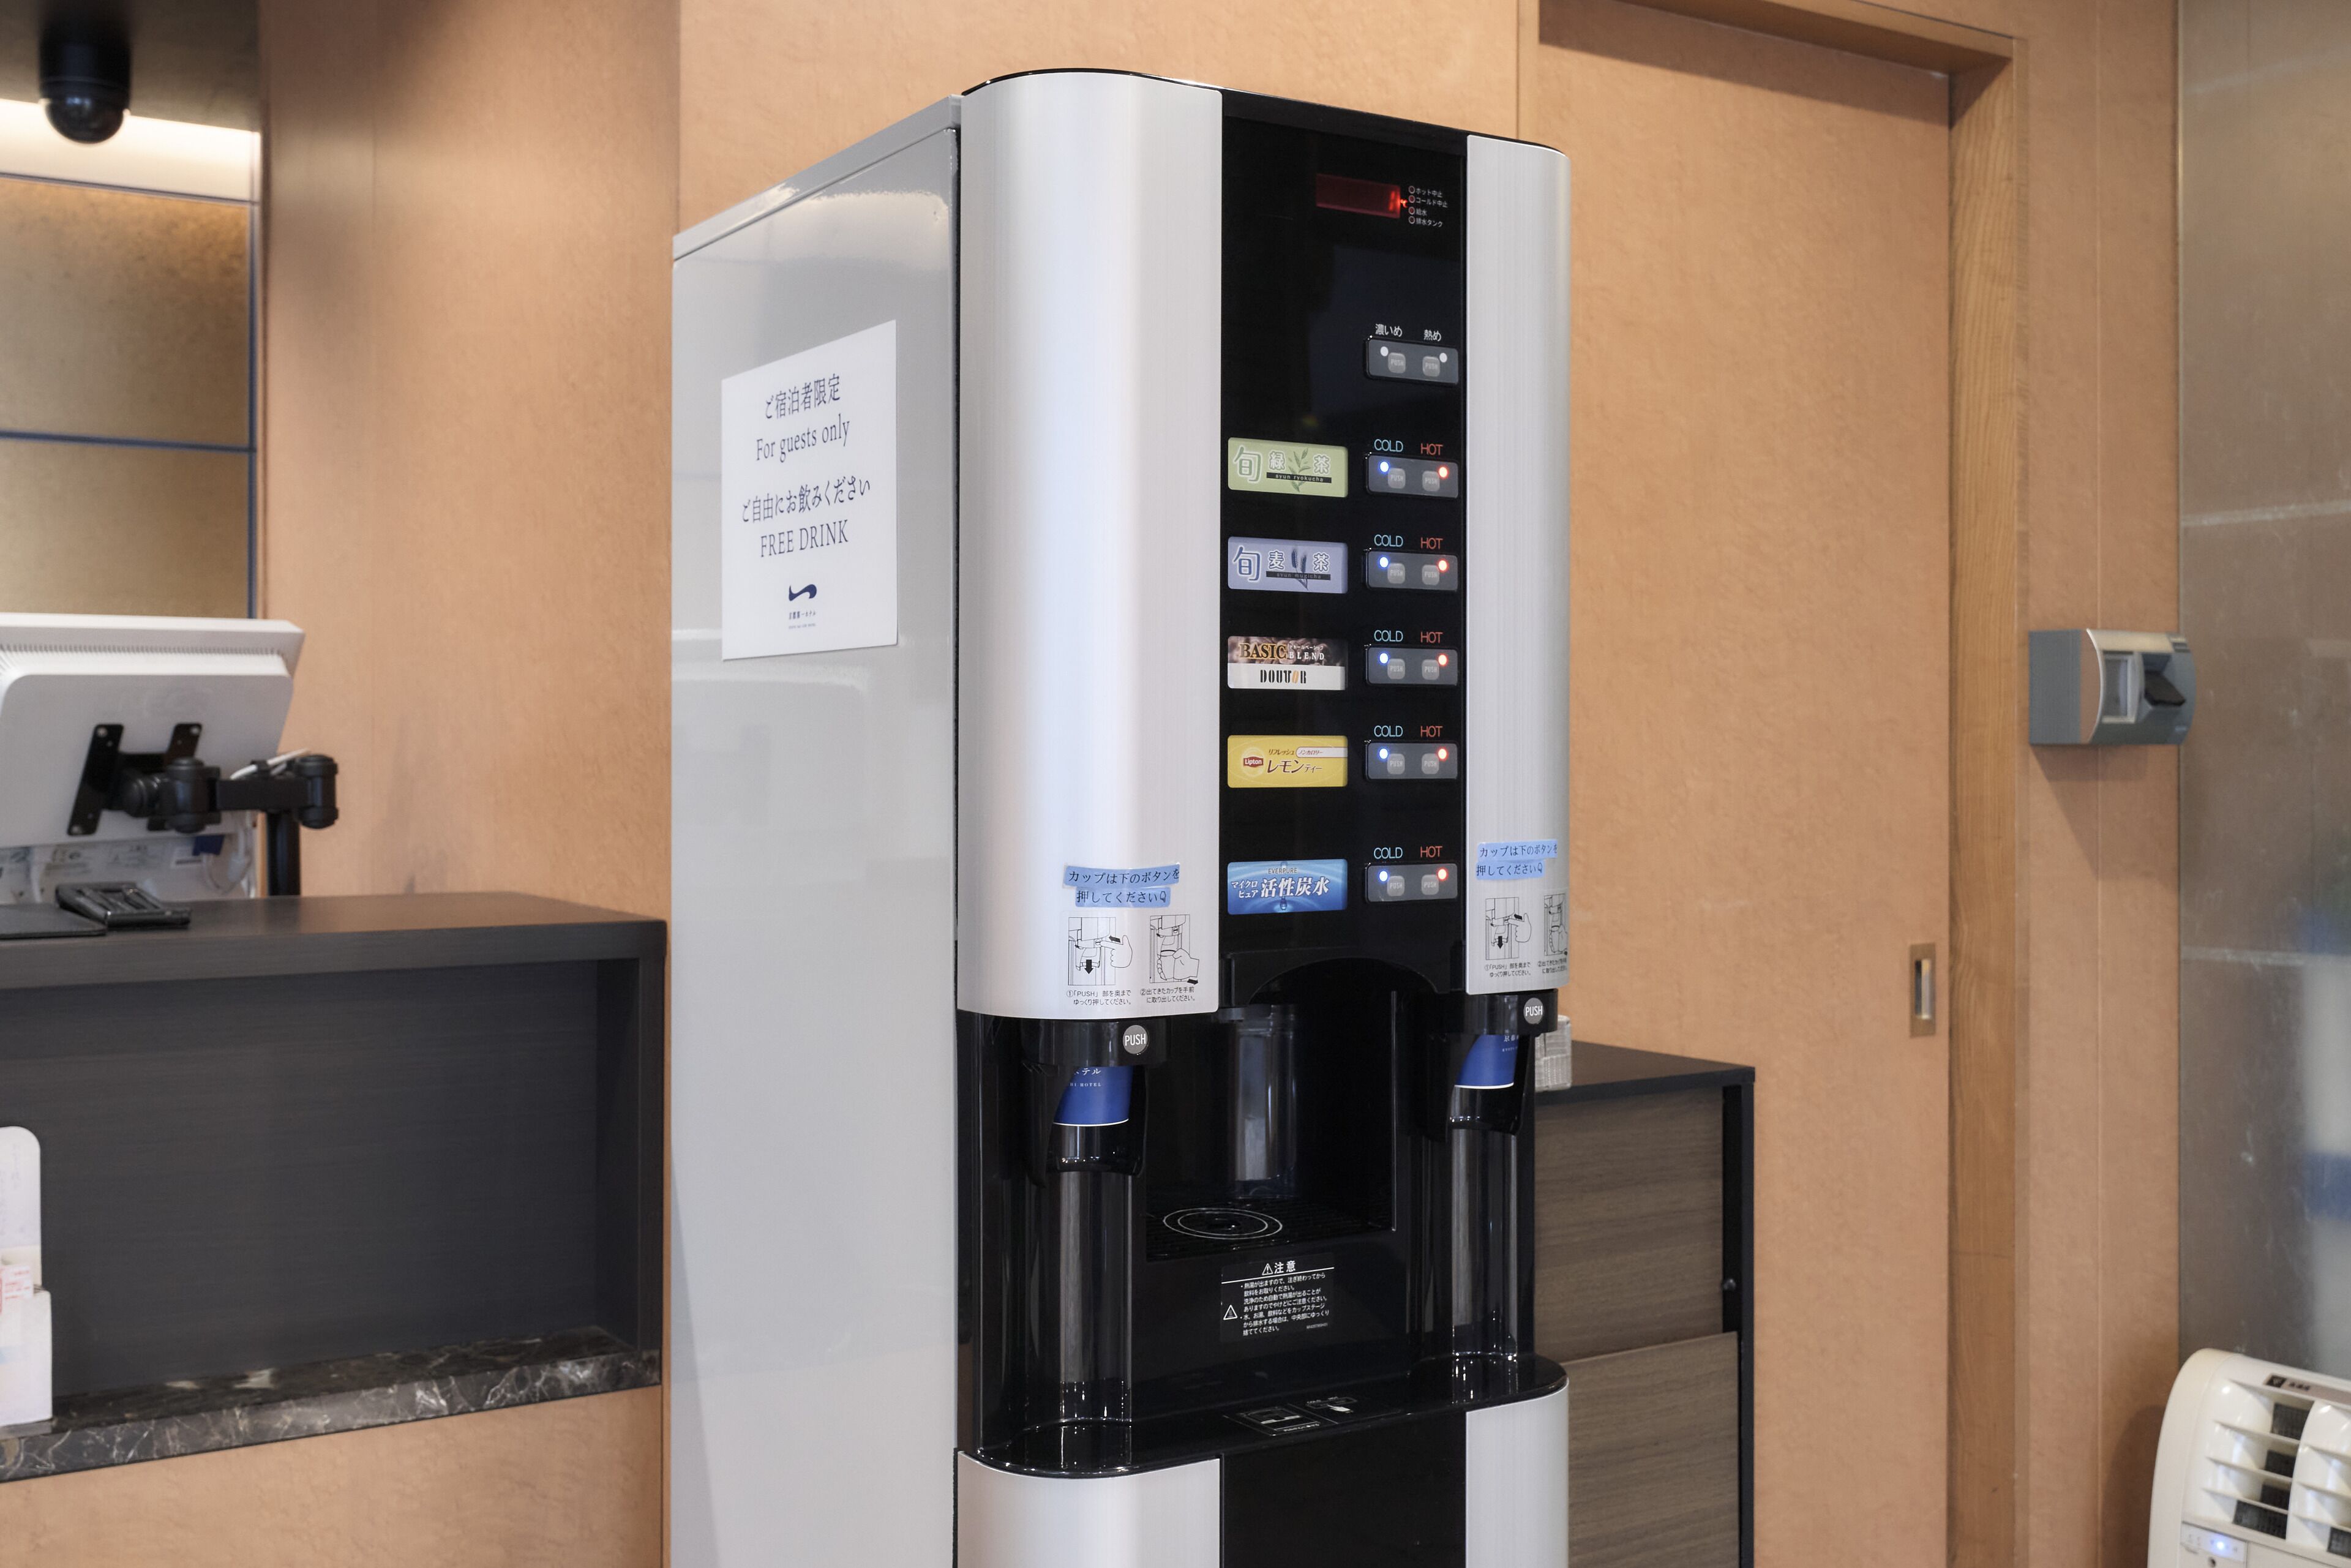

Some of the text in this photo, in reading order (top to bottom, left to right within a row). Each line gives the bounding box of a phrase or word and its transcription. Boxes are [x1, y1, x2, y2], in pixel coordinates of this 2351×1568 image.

[1375, 323, 1442, 342] 濃いめ 熱め
[765, 373, 841, 419] ご宿泊者限定
[756, 413, 850, 463] For guests only
[1374, 438, 1444, 456] COLD HOT
[742, 475, 871, 523] ご自由にお飲みください
[760, 519, 849, 557] FREE DRINK
[1374, 534, 1444, 549] COLD HOT
[1374, 629, 1444, 643] COLD HOT
[1239, 643, 1287, 659] BASIC
[1289, 651, 1325, 660] BLEND
[1374, 725, 1444, 738] COLD HOT
[1267, 759, 1323, 774] レモンティー
[1373, 846, 1443, 860] COLD HOT
[1068, 868, 1180, 884] カップは下のボタンを
[1231, 880, 1258, 889] マイクロ
[1261, 876, 1330, 898] 活性炭水
[1525, 1005, 1543, 1017] PUSH
[1125, 1033, 1146, 1046] PUSH
[1074, 1067, 1101, 1076] テル
[1274, 1260, 1296, 1274] 注意
